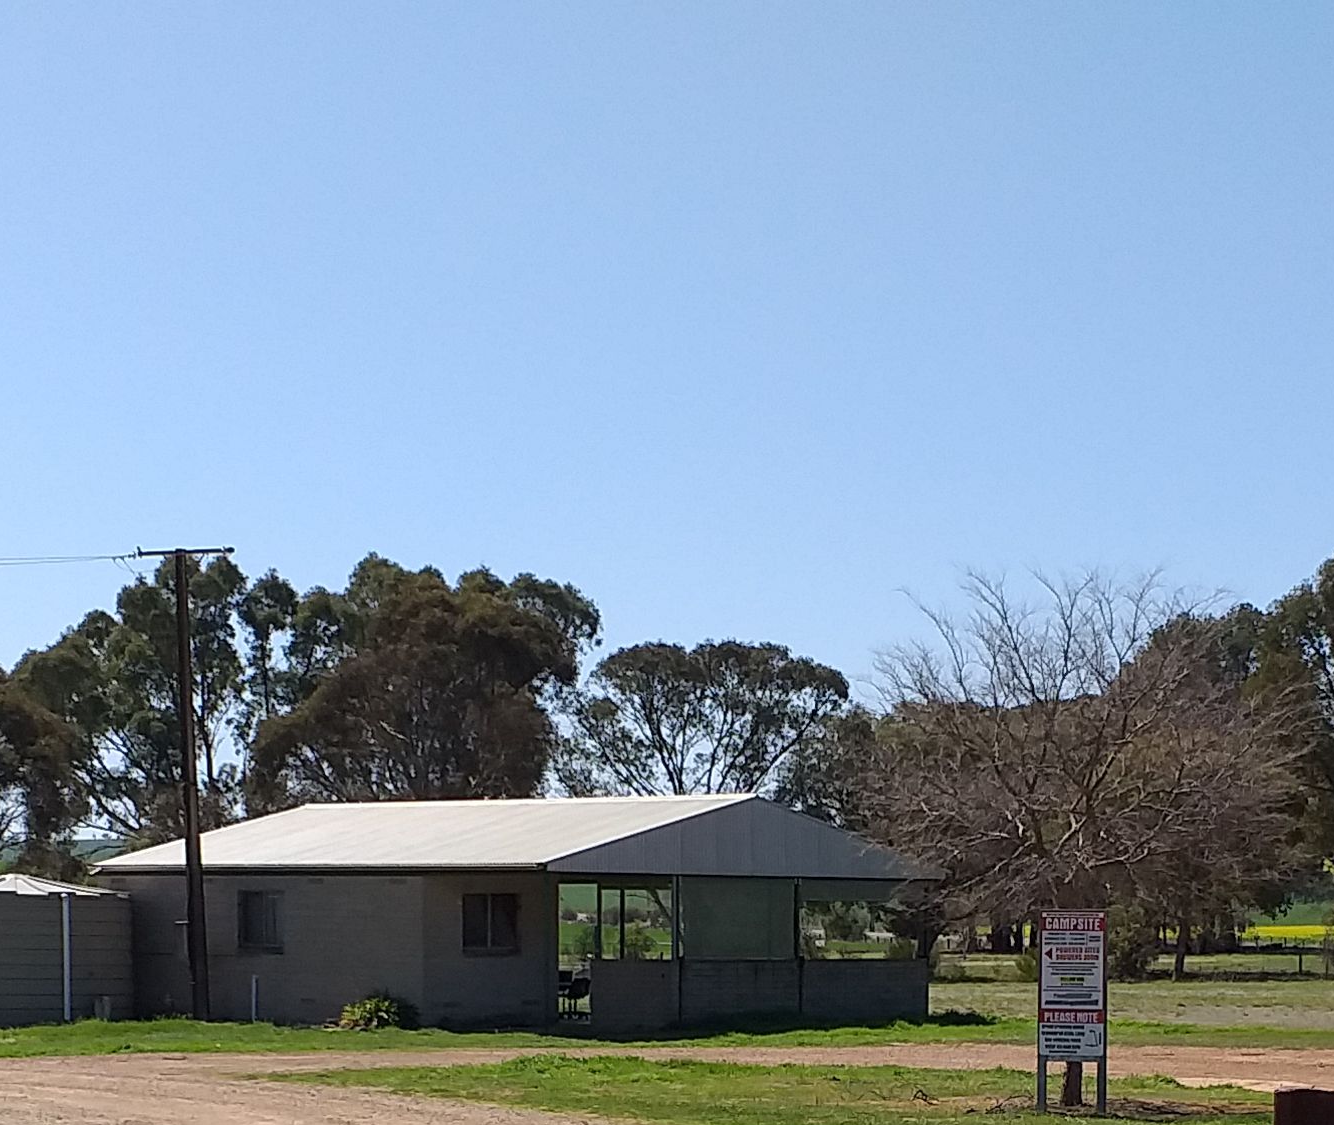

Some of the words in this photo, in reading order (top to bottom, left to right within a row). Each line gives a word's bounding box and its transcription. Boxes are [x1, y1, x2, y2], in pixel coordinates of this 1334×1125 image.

[1045, 917, 1100, 930] CAMPSITE
[1044, 1011, 1076, 1023] PLEASE
[1076, 1012, 1099, 1024] NOTE
